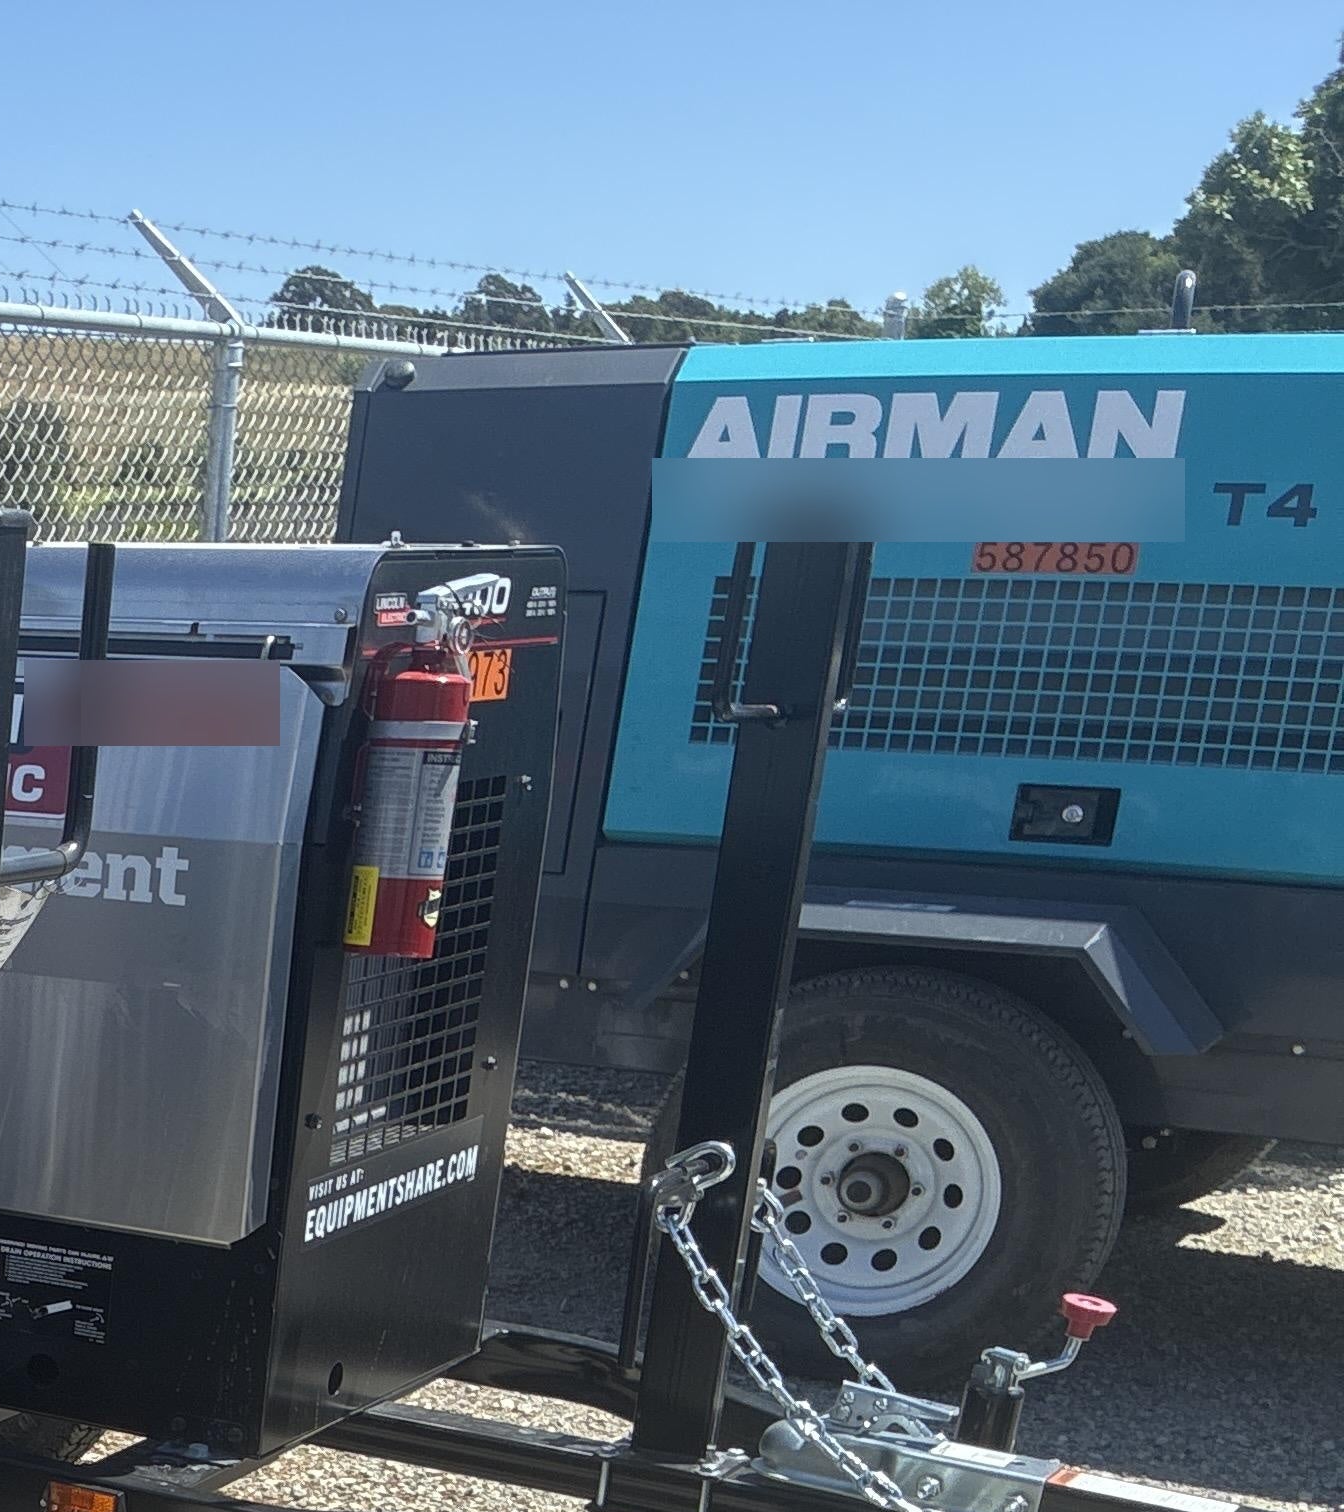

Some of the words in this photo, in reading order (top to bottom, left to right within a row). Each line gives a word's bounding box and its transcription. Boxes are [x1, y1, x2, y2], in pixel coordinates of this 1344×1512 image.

[686, 389, 1186, 459] AIRMAN
[1213, 481, 1317, 527] T4
[974, 541, 1135, 573] 587850
[304, 1144, 479, 1243] EQUIPMENTSHARE.COM
[309, 1179, 334, 1201] VISIT
[335, 1173, 348, 1190] US
[350, 1168, 365, 1186] AT:
